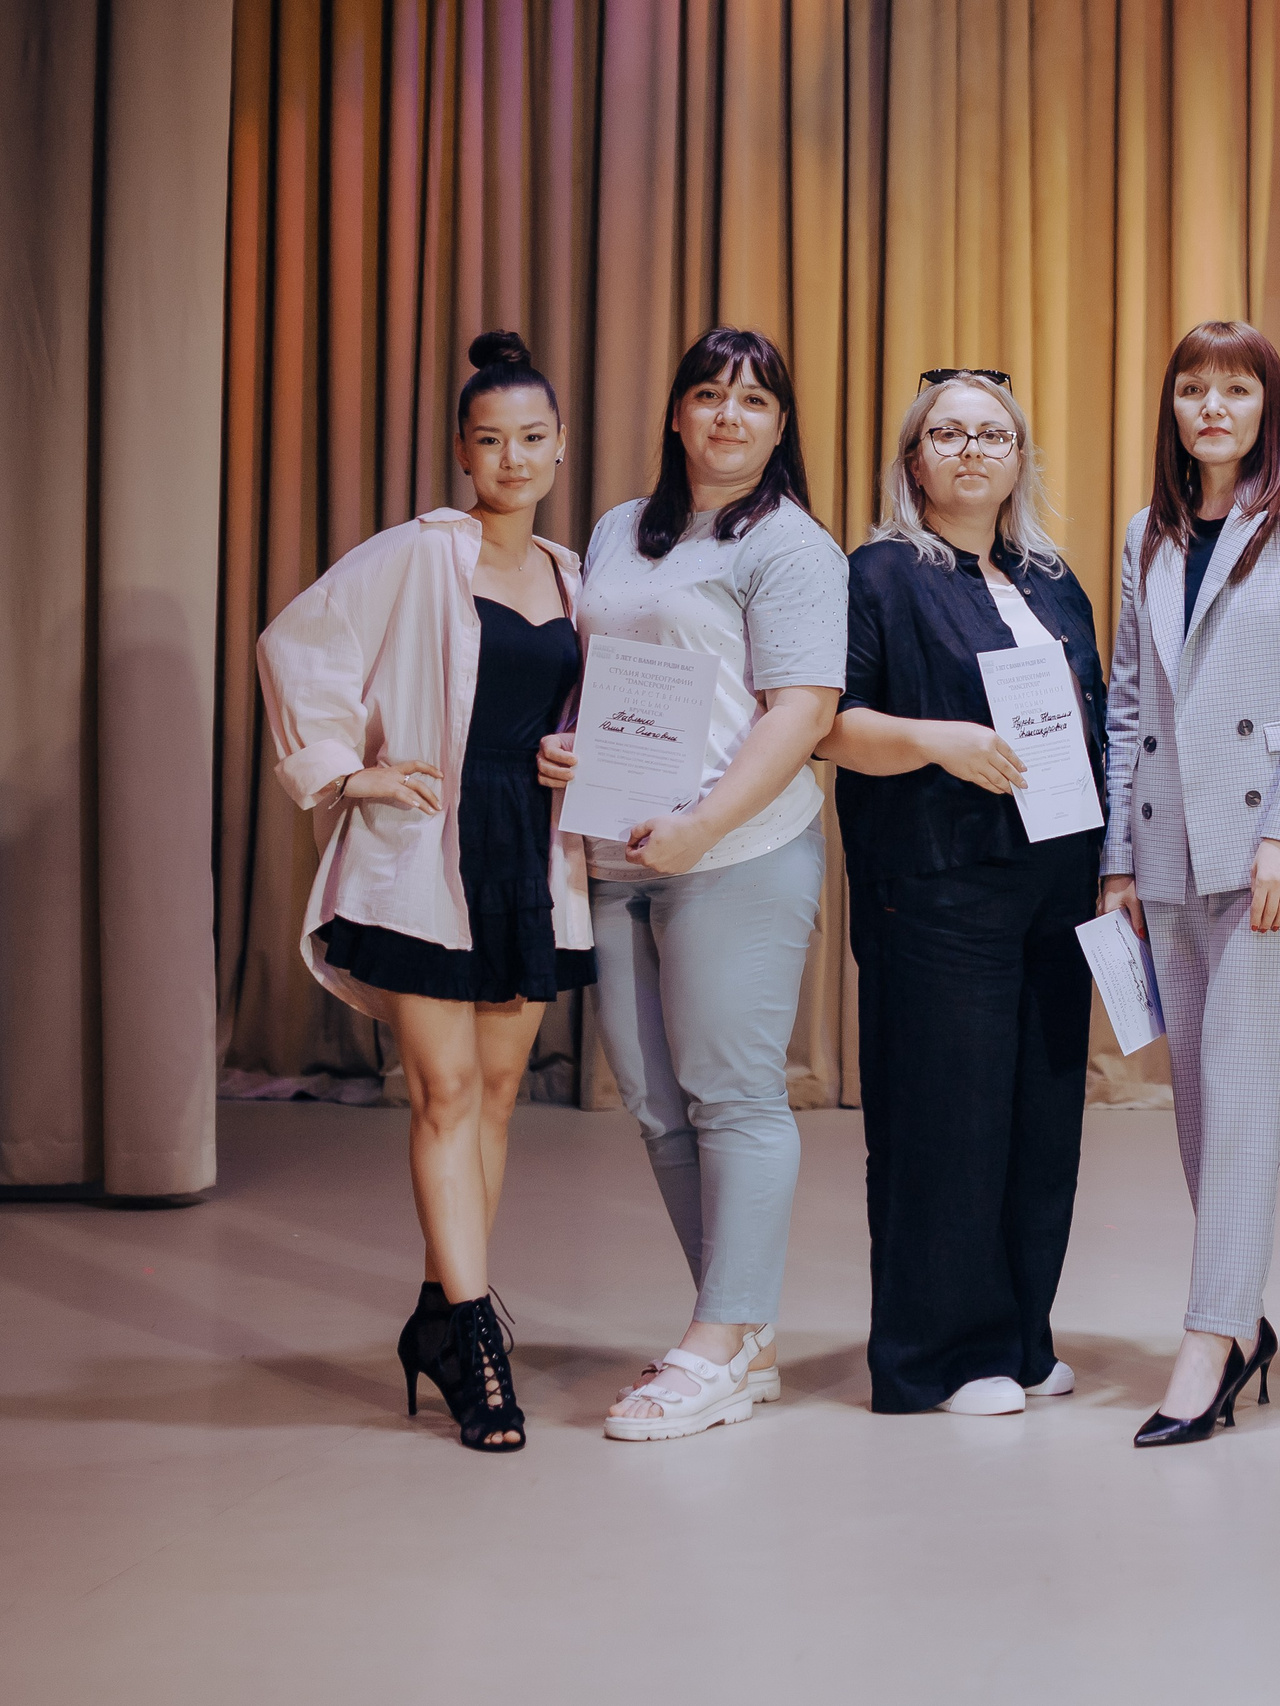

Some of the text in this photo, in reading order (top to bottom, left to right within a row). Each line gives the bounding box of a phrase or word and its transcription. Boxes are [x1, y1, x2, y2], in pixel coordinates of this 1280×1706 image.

[620, 654, 632, 662] ЛЕТ
[638, 658, 656, 666] ВАМИ
[662, 662, 680, 670] РАДИ
[609, 667, 693, 687] СТУДИЯ ХОРЕОГРАФИИ
[624, 697, 670, 710] ПИСЬМО
